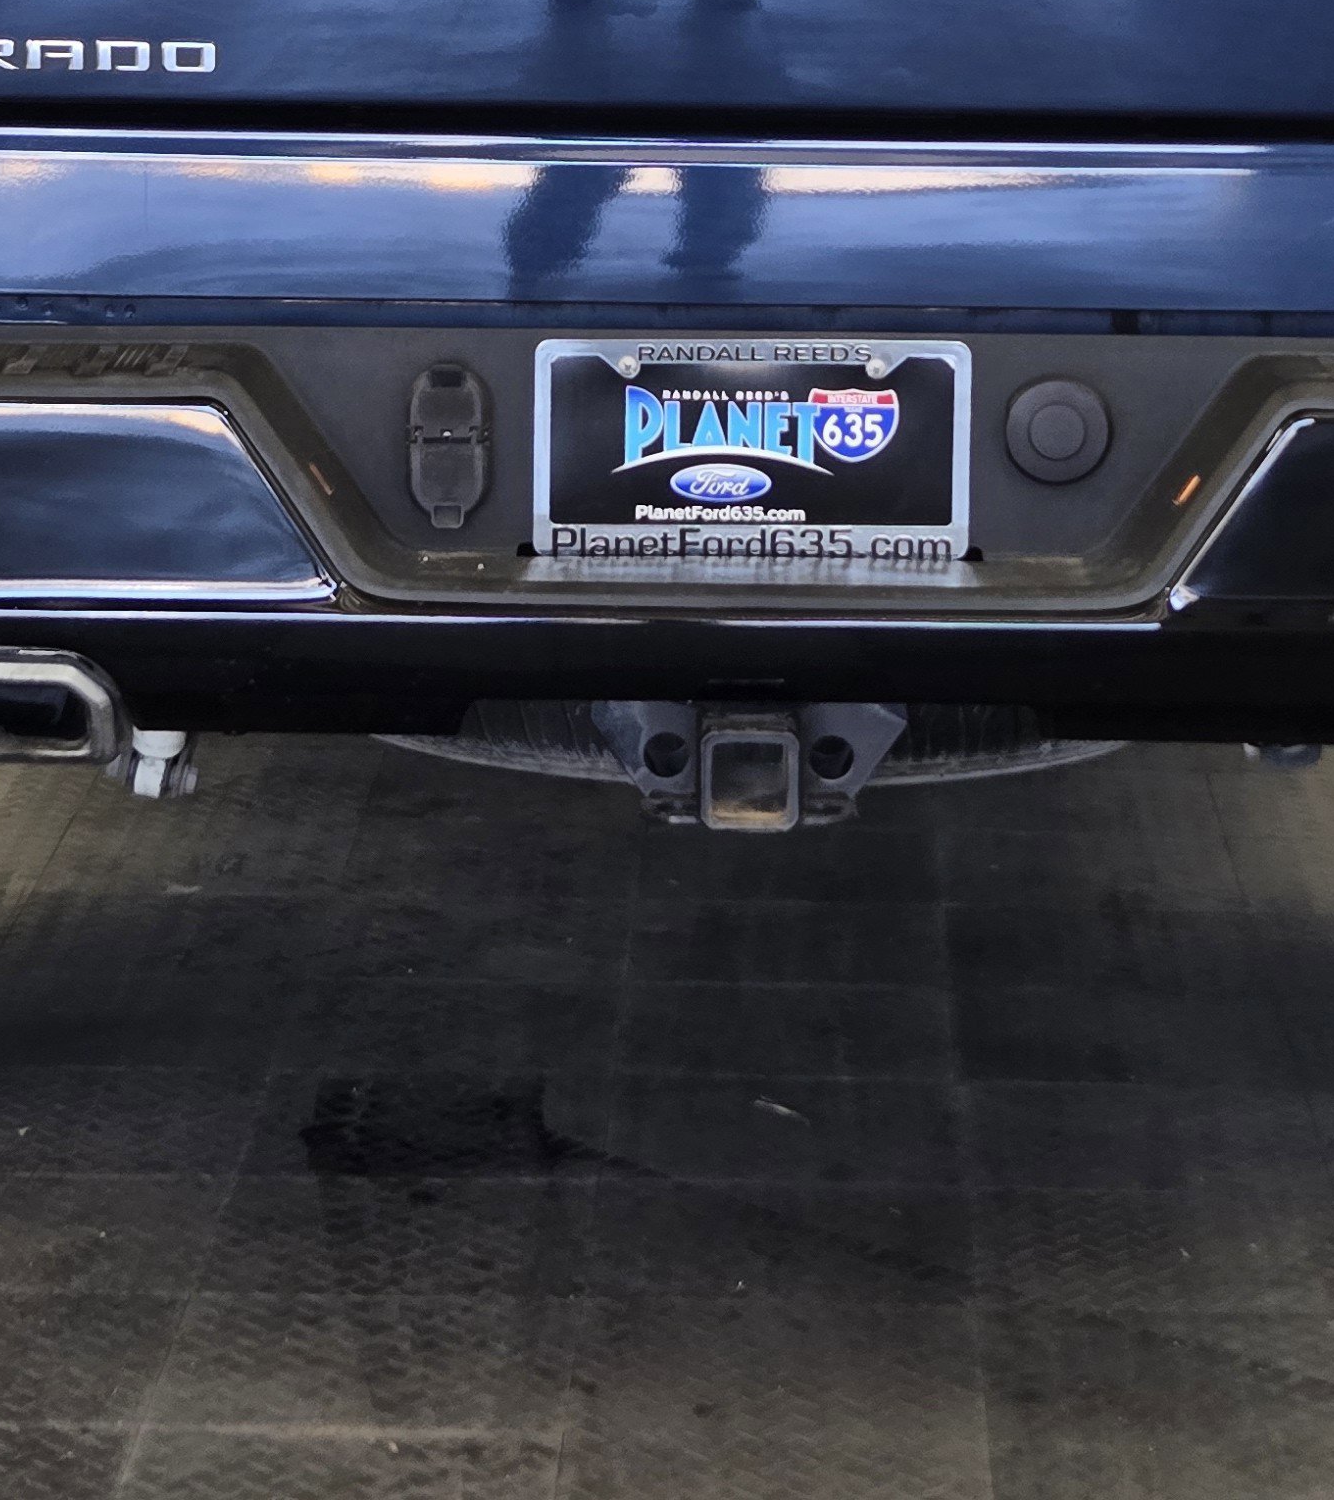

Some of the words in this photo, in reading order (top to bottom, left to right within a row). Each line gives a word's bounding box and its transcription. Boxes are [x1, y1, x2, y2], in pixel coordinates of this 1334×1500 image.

[637, 344, 765, 363] RANDALL
[773, 344, 873, 363] REED'S
[822, 413, 884, 449] 635
[688, 467, 751, 498] Ford
[634, 504, 807, 522] PlanetFord635.com
[551, 526, 953, 561] PlanetFord635.com
